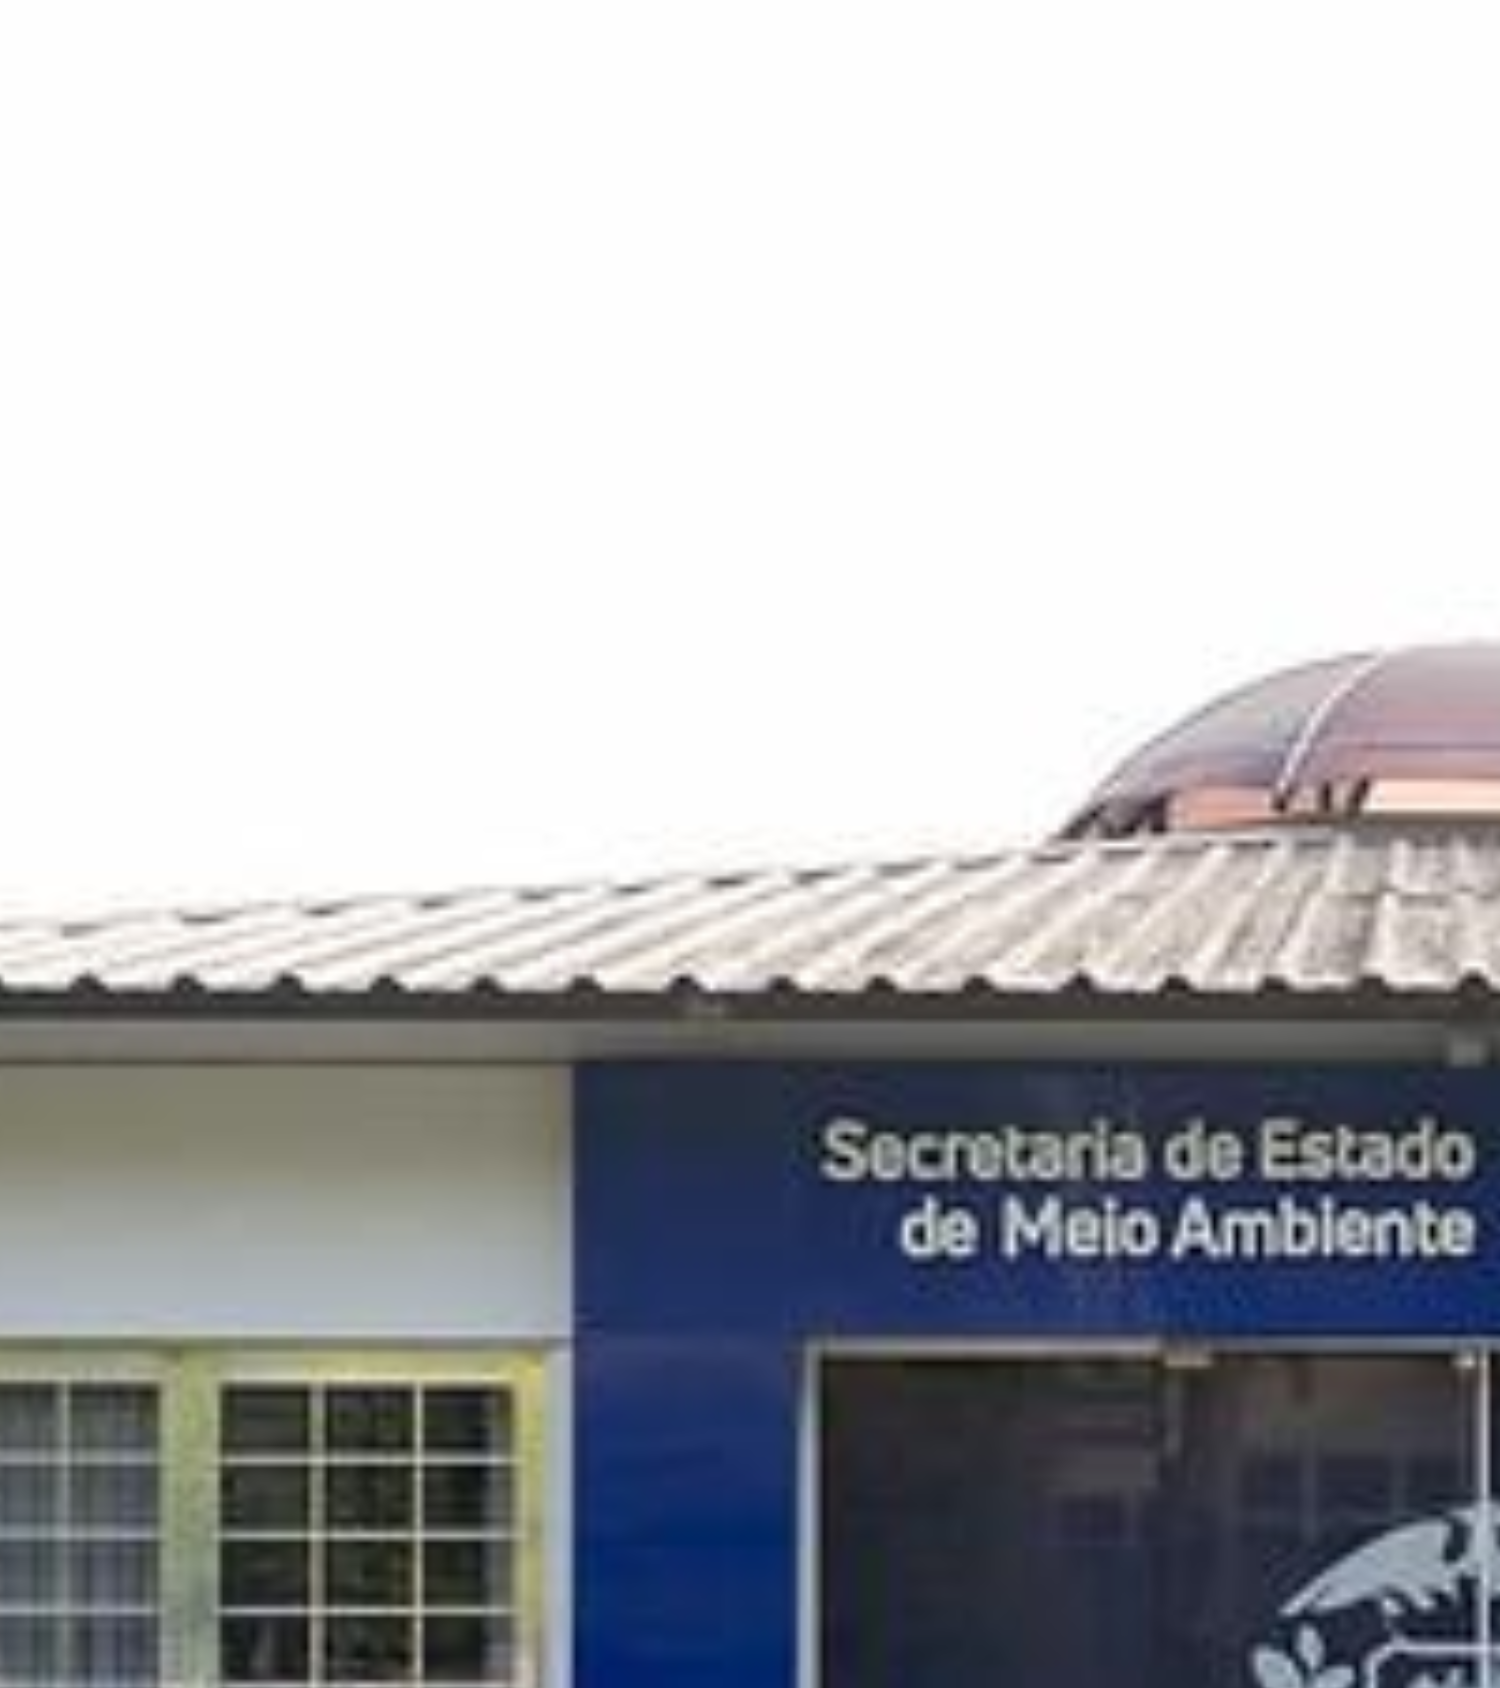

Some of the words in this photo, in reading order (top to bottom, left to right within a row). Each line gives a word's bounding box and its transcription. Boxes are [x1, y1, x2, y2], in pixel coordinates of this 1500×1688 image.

[821, 1118, 1149, 1182] Secretaria
[1163, 1118, 1244, 1182] de
[1259, 1118, 1476, 1182] Estado
[899, 1197, 979, 1259] de
[1001, 1197, 1161, 1259] Meio
[1169, 1195, 1477, 1259] Ambiente
